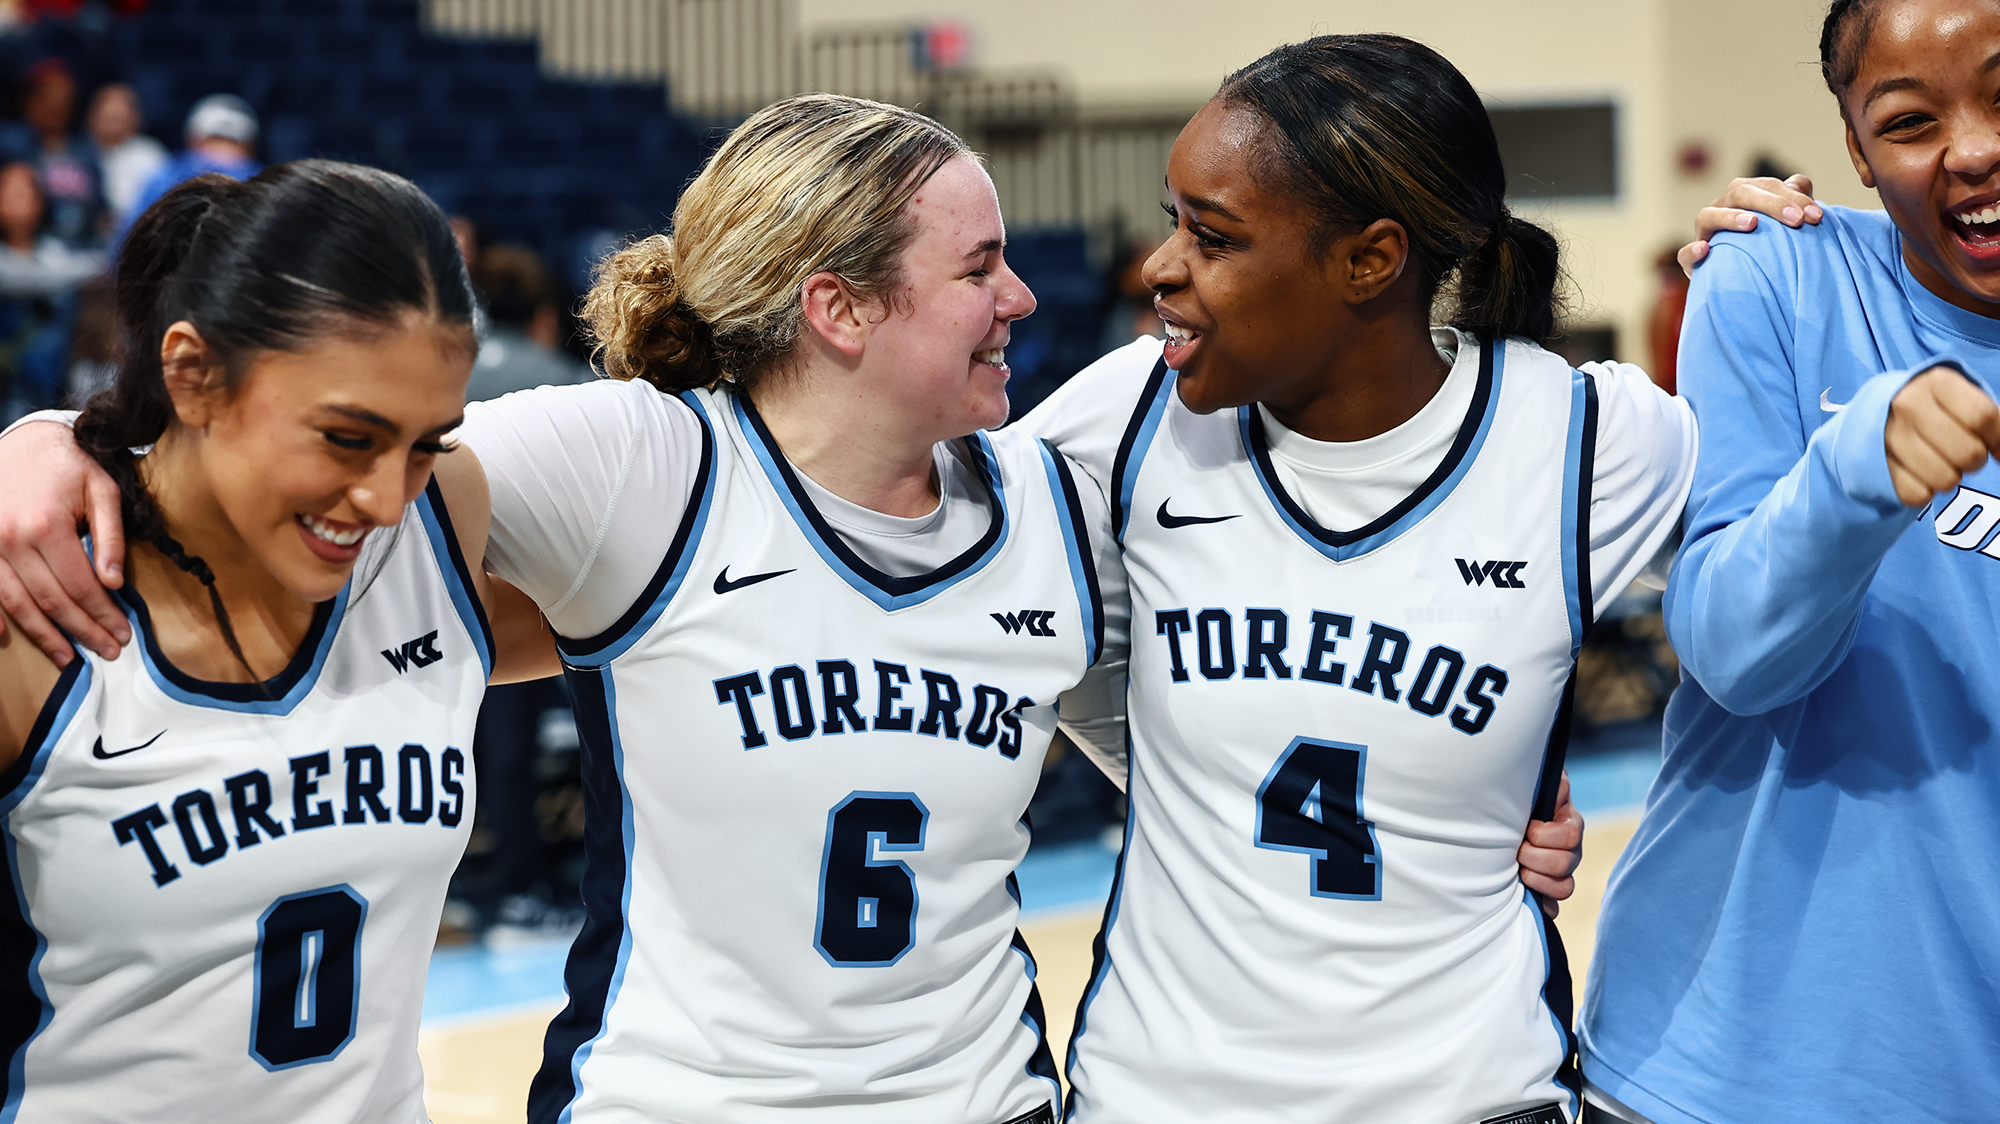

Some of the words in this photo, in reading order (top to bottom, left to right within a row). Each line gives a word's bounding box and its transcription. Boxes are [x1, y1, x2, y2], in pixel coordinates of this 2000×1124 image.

[989, 609, 1057, 637] WCC
[1454, 558, 1528, 588] WCC
[380, 629, 443, 675] WCC
[712, 658, 1037, 761] TOREROS
[1155, 606, 1509, 737] TOREROS
[111, 743, 464, 889] TOREROS
[813, 790, 930, 968] 6
[1254, 735, 1382, 902] 4
[248, 883, 369, 1073] 0
